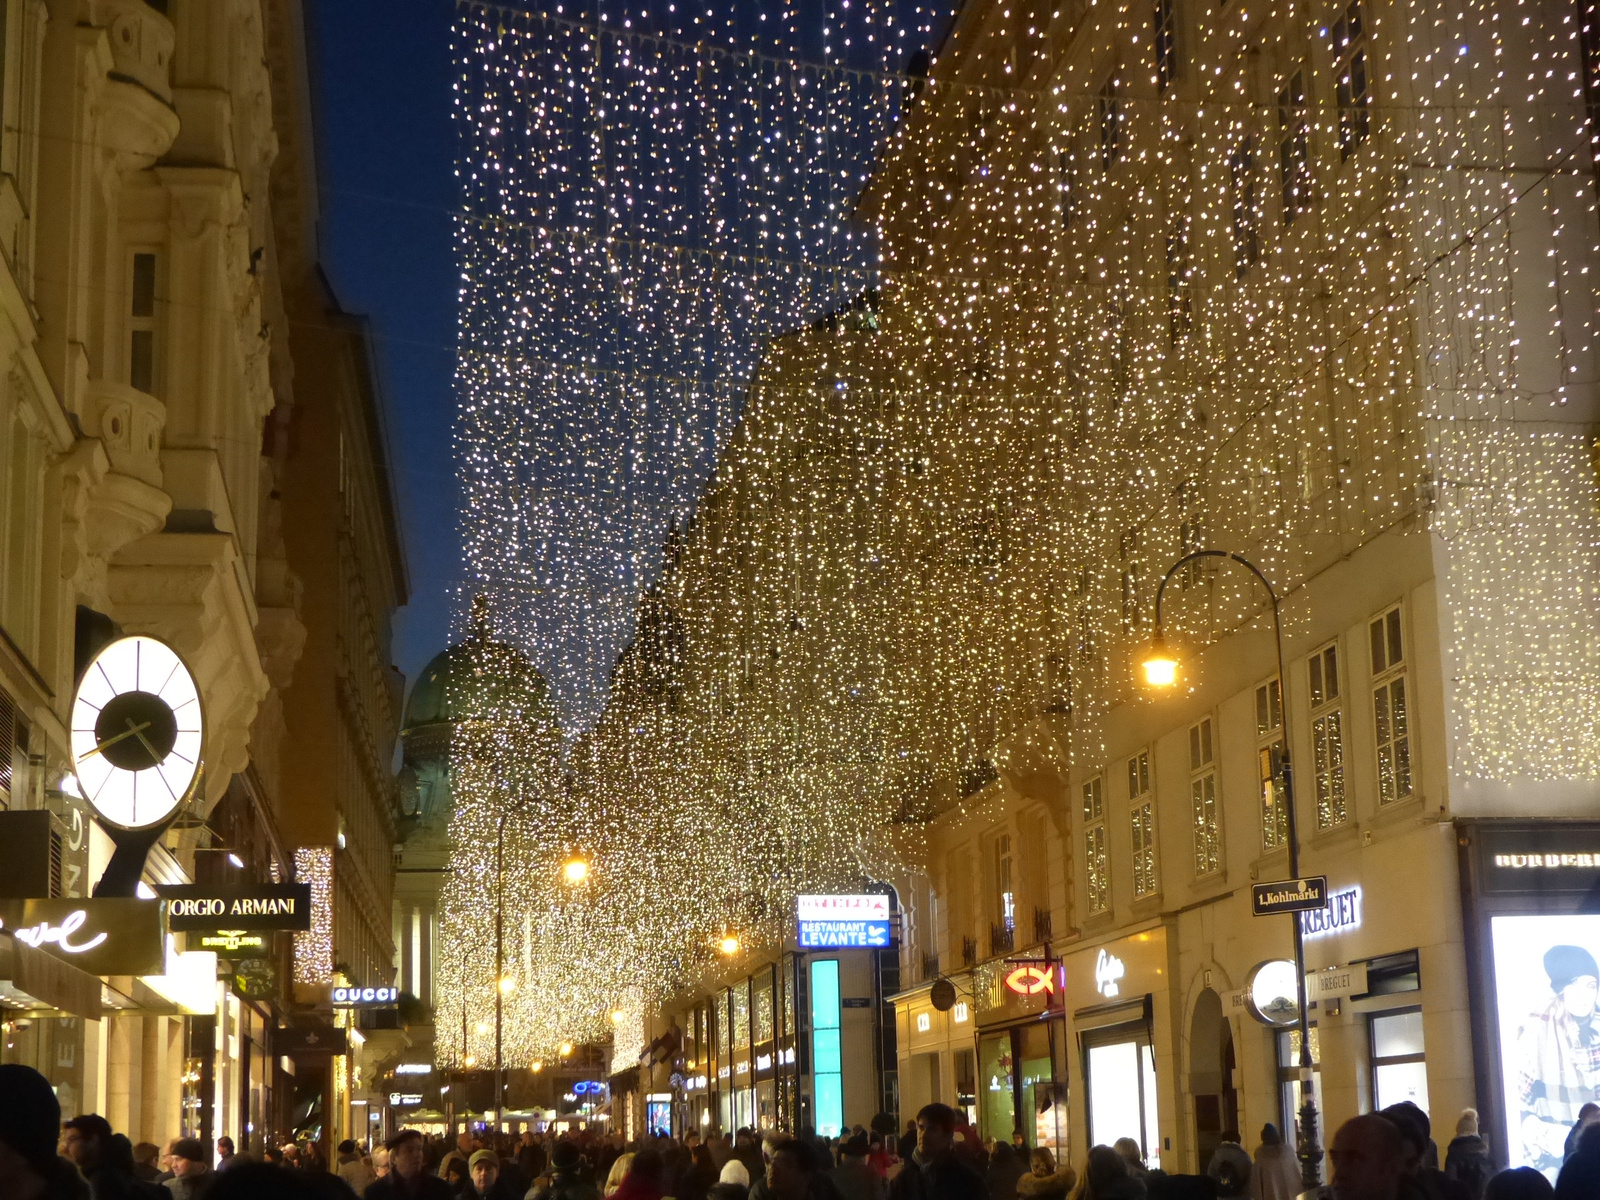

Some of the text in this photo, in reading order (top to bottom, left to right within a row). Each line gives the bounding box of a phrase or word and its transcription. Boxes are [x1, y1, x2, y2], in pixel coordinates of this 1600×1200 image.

[168, 898, 295, 916] IORGIO ARMANI
[1300, 889, 1357, 935] REGUET
[802, 922, 866, 933] RESTAURANT
[802, 932, 867, 946] LEVANTE
[1321, 974, 1350, 991] BREGUET
[334, 987, 397, 1001] GUCCI
